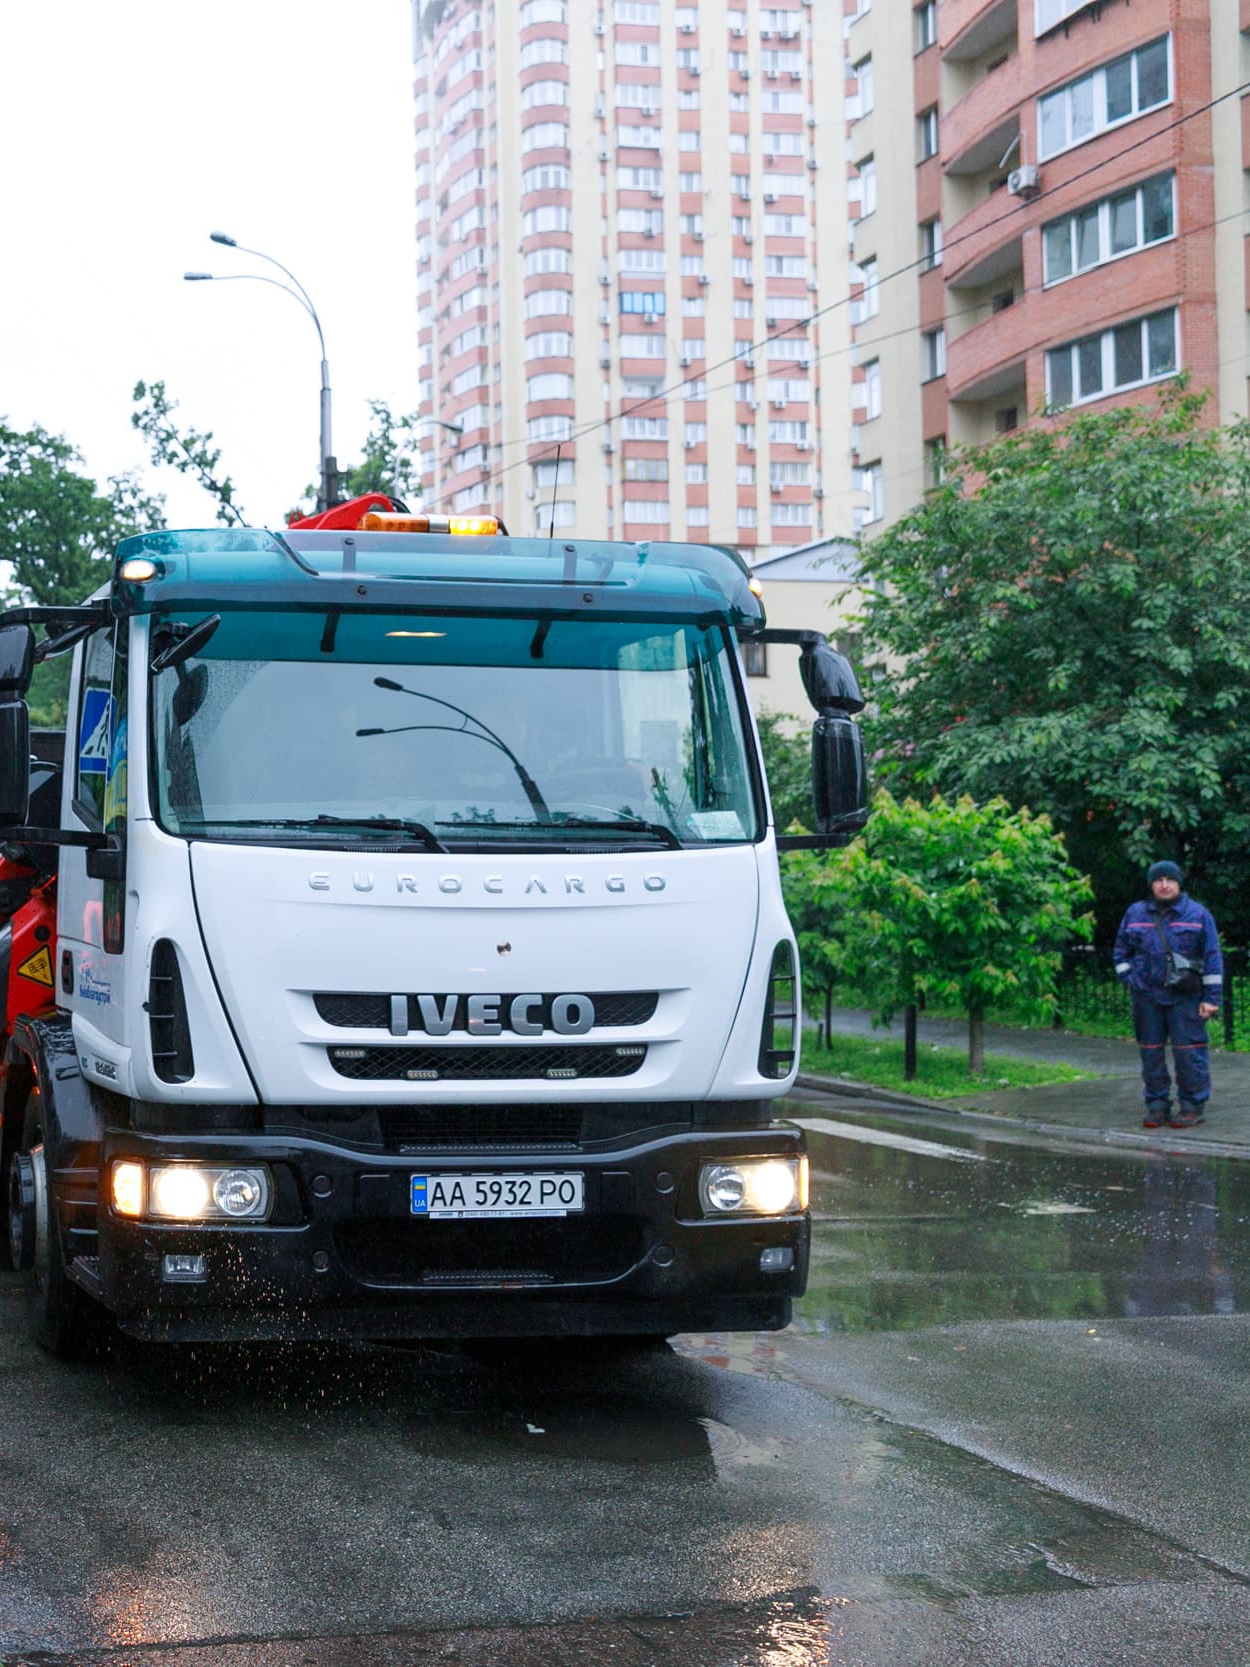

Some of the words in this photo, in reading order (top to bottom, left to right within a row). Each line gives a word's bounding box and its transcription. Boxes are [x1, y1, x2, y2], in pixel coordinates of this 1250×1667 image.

[307, 870, 667, 895] EUROCARGO
[388, 993, 596, 1037] IVECO
[414, 1199, 427, 1208] UA
[430, 1181, 467, 1207] AA
[474, 1180, 532, 1206] 5932
[540, 1179, 576, 1205] PO
